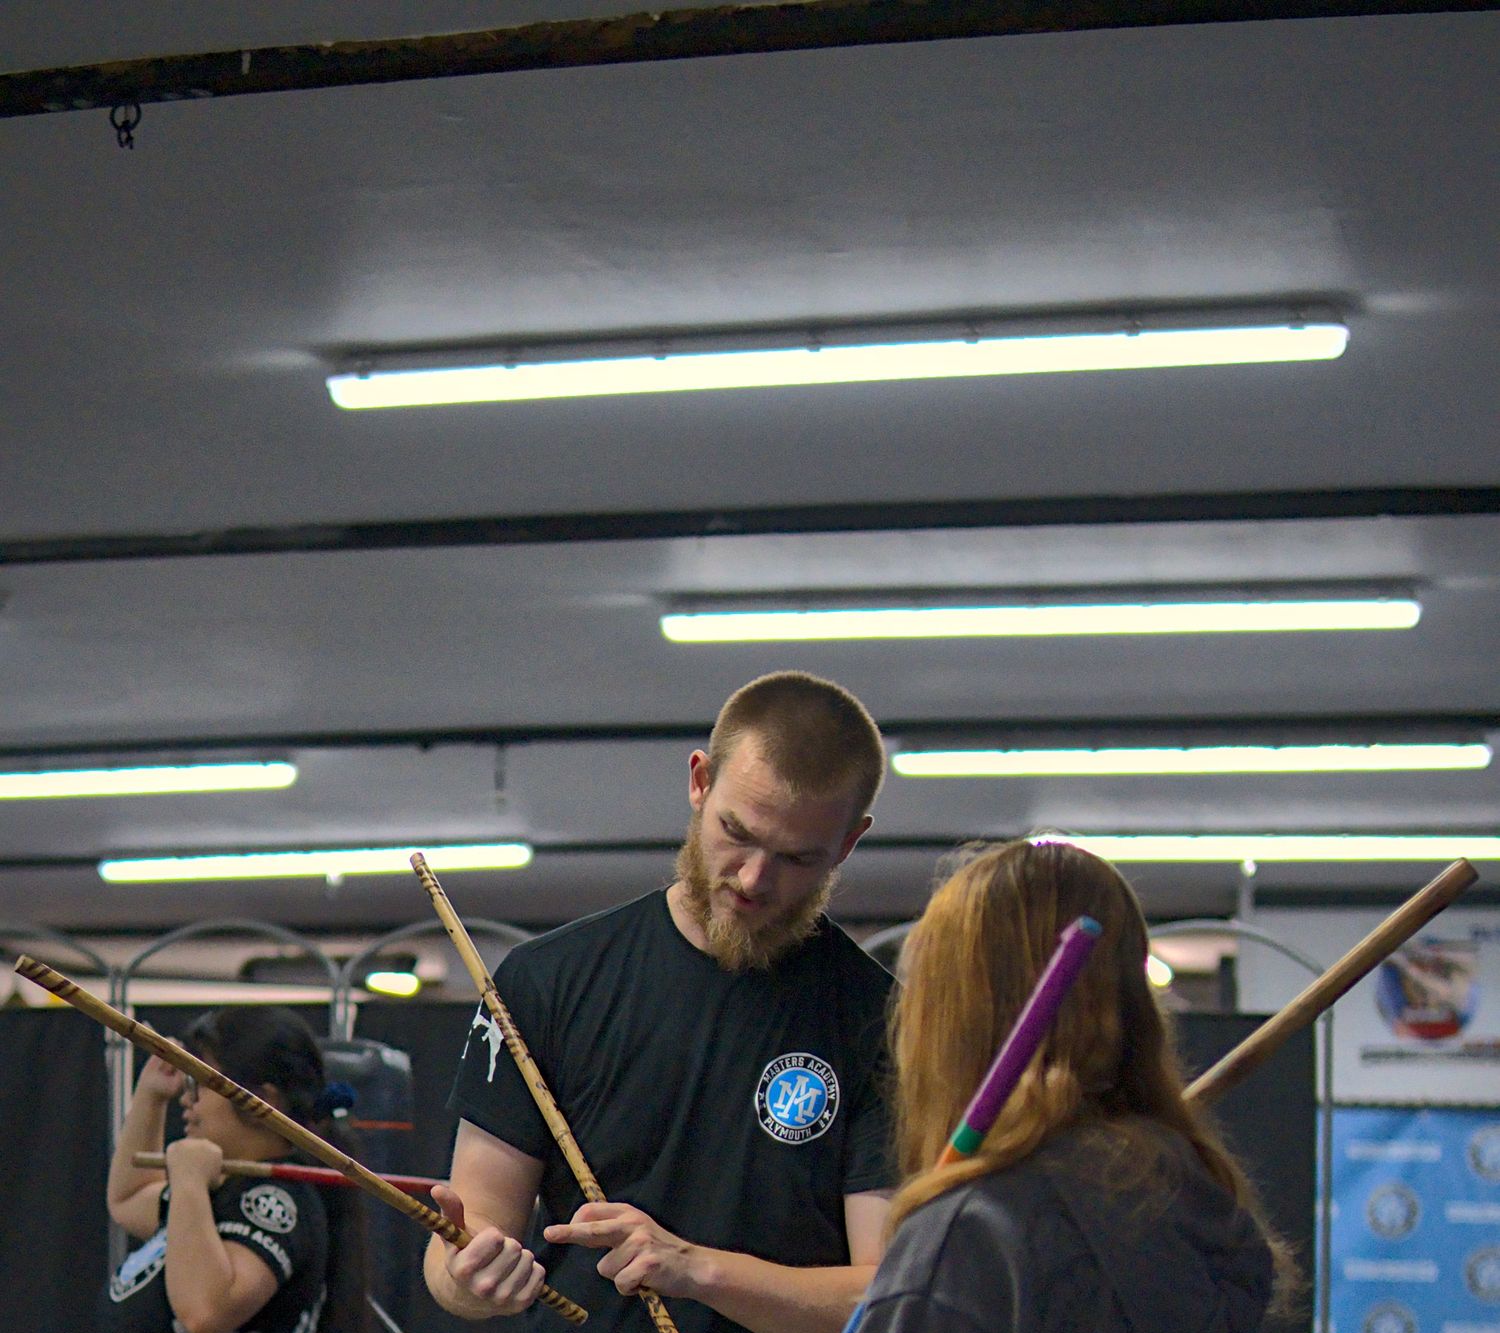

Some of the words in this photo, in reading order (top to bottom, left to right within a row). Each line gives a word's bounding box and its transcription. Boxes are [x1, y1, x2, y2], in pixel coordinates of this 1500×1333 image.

[763, 1056, 805, 1083] MASTERS
[807, 1059, 837, 1100] ACADEMY
[763, 1116, 812, 1140] PLYMOUTH
